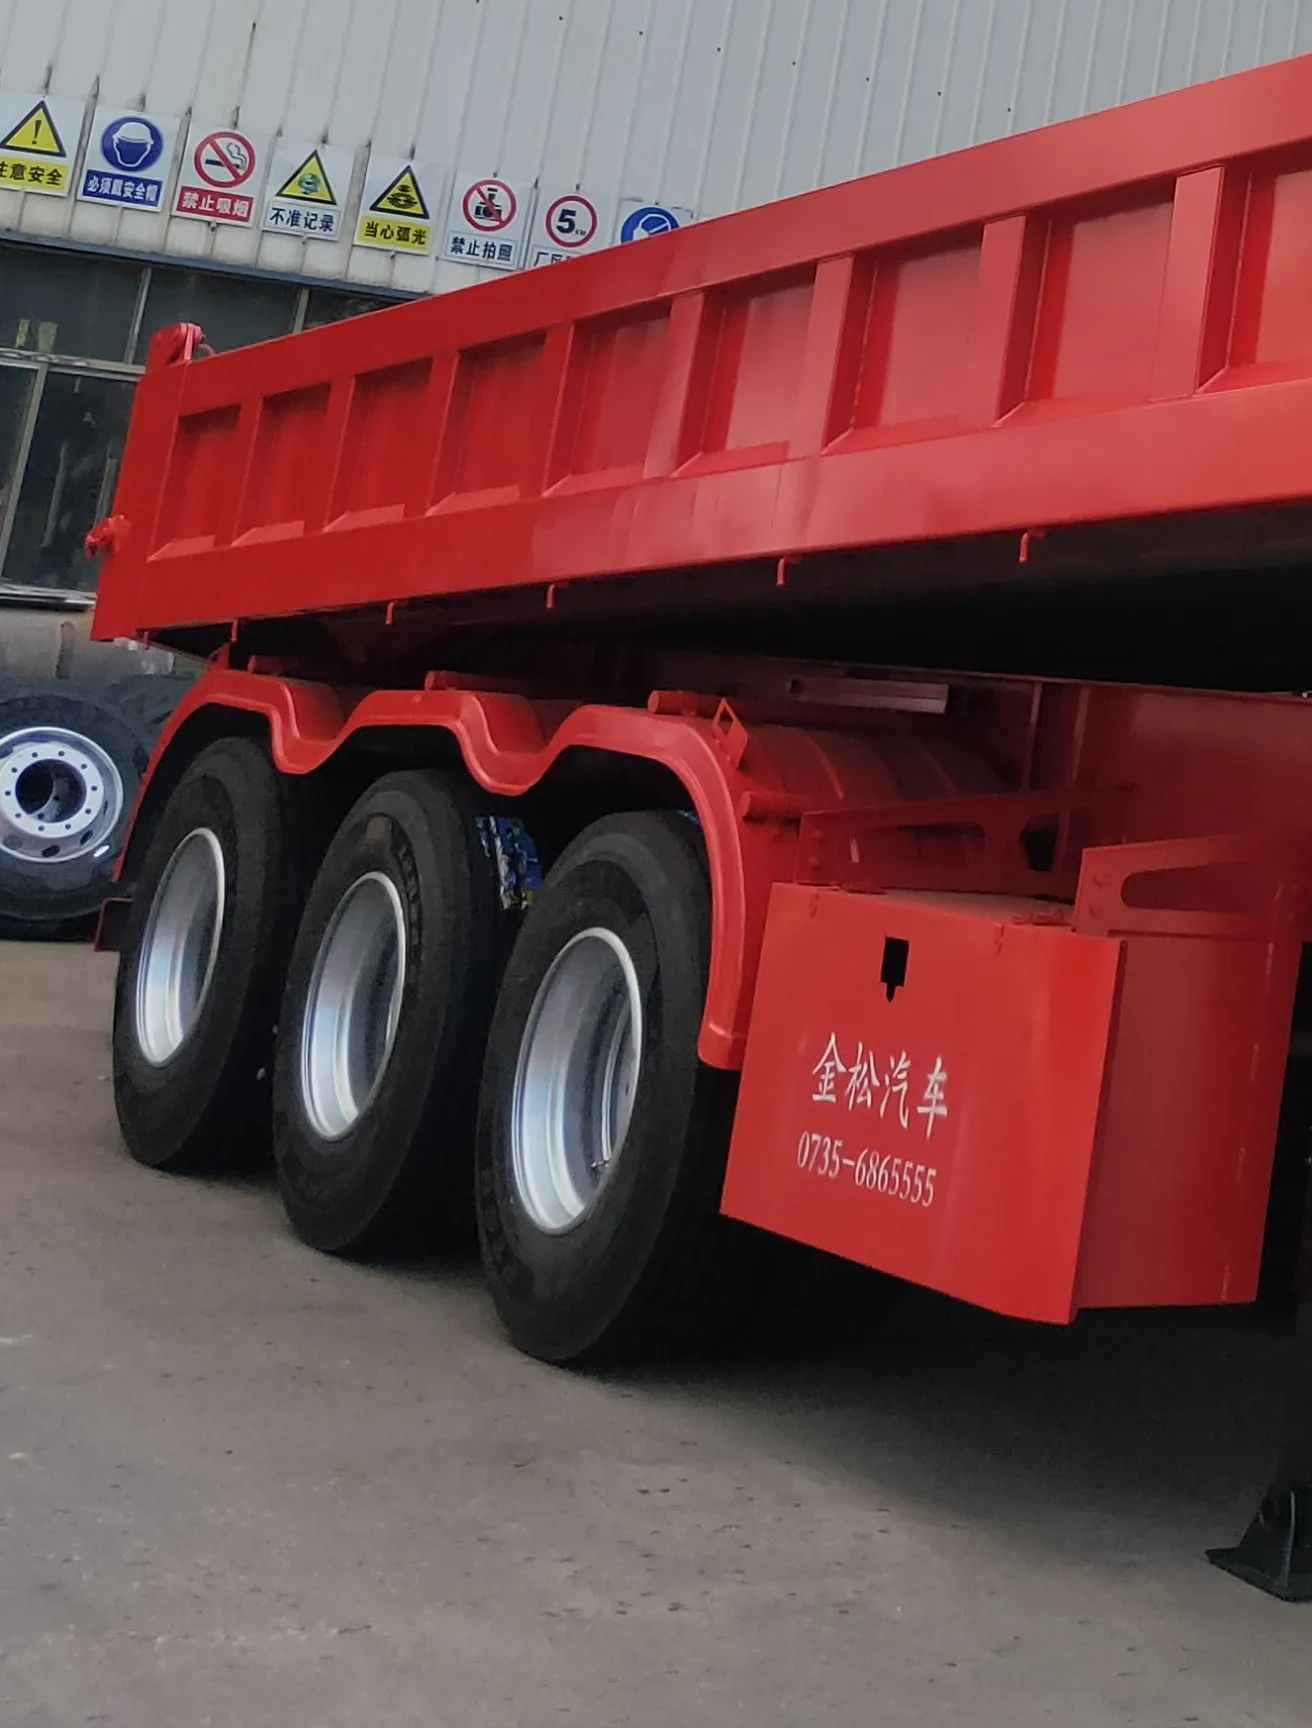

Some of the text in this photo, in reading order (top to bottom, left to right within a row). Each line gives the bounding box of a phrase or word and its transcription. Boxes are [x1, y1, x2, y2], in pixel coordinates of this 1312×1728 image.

[181, 191, 250, 218] 禁止吸烟
[269, 206, 336, 233] 不准记录
[363, 220, 428, 246] 当心弧光
[450, 236, 513, 262] 禁止拍照
[811, 1031, 949, 1141] 金松汽车
[796, 1130, 938, 1208] 0735-6865555
